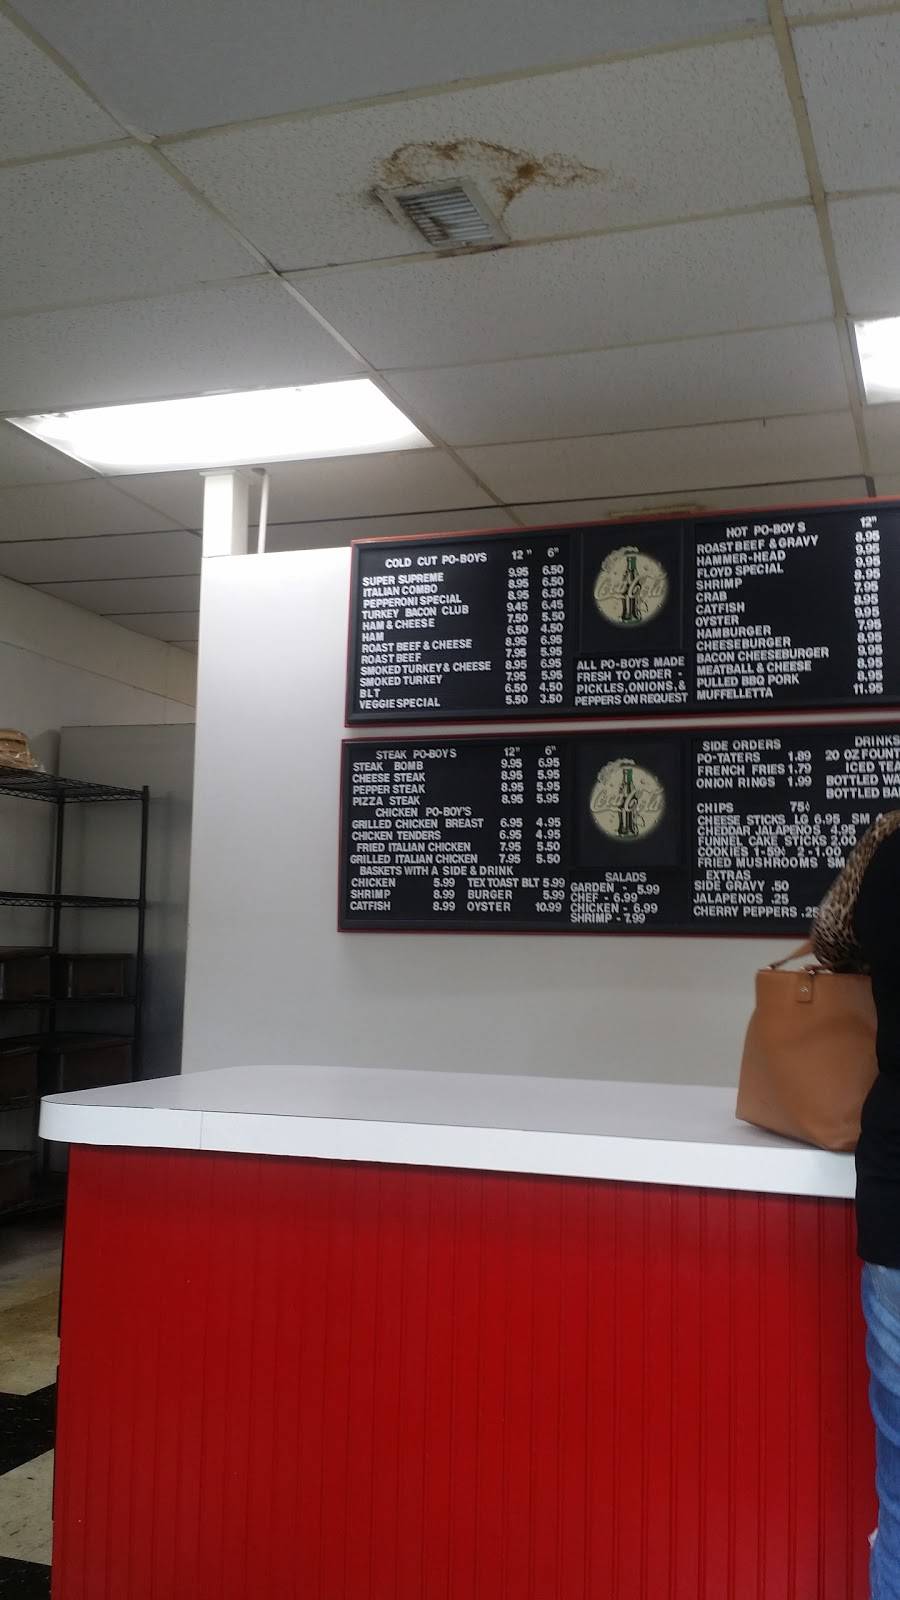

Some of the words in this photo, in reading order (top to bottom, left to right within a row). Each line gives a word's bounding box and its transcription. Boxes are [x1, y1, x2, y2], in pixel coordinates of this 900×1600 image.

[726, 526, 748, 538] HOT
[697, 542, 734, 554] ROAST
[735, 539, 765, 551] BEEF
[769, 538, 777, 549] &
[778, 535, 818, 548] GRAVY
[385, 558, 412, 568] COLD
[417, 556, 438, 566] CUT
[442, 553, 487, 564] PO-BOYS
[697, 550, 786, 566] HAMMER-HEAD
[697, 566, 732, 578] FLOYD
[735, 563, 784, 576] SPECIAL
[362, 576, 395, 586] SUPER
[398, 573, 444, 584] SUPREME
[696, 578, 742, 590] SHRIMP
[363, 586, 400, 597] ITALIAN
[401, 584, 438, 595] COMBO
[696, 591, 727, 602] CRAB
[363, 597, 418, 608] PEPPERONI
[419, 594, 462, 605] SPECIAL
[361, 609, 399, 619] TURKEY
[405, 607, 436, 617] BACON
[441, 605, 469, 615] CLUB
[696, 602, 745, 614] CATFISH
[362, 621, 384, 630] HAM
[386, 620, 393, 630] &
[395, 618, 435, 629] CHEESE
[696, 615, 739, 627] OYSTER
[362, 632, 384, 642] HAM
[697, 625, 771, 638] HAMBURGER
[362, 643, 394, 653] ROAST
[396, 641, 421, 651] BEEF
[423, 641, 430, 650] &
[432, 639, 472, 650] CHEESE
[696, 637, 791, 651] CHEESEBURGER
[361, 654, 395, 664] ROAST
[396, 653, 421, 663] BEEF
[697, 652, 734, 663] BACON
[738, 647, 829, 661] CHEESEBURGER
[360, 665, 401, 675] SMOKED
[402, 663, 441, 673] TURKEY
[441, 663, 450, 672] &
[453, 661, 491, 671] CHEESE
[577, 660, 597, 670] ALL
[601, 658, 649, 669] PO-BOYS
[654, 656, 684, 667] MADE
[697, 663, 754, 675] MEATBALL
[756, 662, 764, 673] &
[767, 660, 811, 672] CHEESE
[360, 676, 401, 687] SMOKED
[402, 675, 442, 685] TURKEY
[577, 671, 611, 682] FRESH
[616, 670, 631, 680] TO
[634, 669, 672, 680] ORDER
[697, 676, 738, 688] PULLED
[742, 675, 765, 686] BBQ
[768, 674, 799, 685] PORK
[360, 688, 380, 698] BLT
[575, 695, 621, 705] PEPPERS
[623, 694, 638, 704] ON
[640, 693, 688, 703] REQUEST
[697, 687, 773, 700] MUFFELLETTA
[359, 699, 395, 709] VEGGIE
[396, 698, 440, 708] SPECIAL
[702, 741, 728, 751] SIDE
[733, 739, 781, 750] ORDERS
[376, 750, 407, 760] STEAK
[697, 752, 760, 763] PO-TATERS
[788, 751, 811, 761] 1.89
[353, 762, 383, 771] STEAK
[394, 761, 423, 770] BOMB
[698, 765, 745, 776] FRENCH
[752, 764, 785, 775] FRIES
[788, 763, 812, 774] 1.79
[846, 761, 875, 773] ICED
[352, 773, 390, 783] CHEESE
[393, 773, 425, 782] STEAK
[696, 778, 733, 788] ONION
[738, 777, 775, 788] RINGS
[788, 776, 812, 787] 1.99
[353, 785, 390, 794] PEPPER
[392, 784, 425, 794] STEAK
[353, 796, 383, 806] PIZZA
[389, 796, 420, 805] STEAK
[375, 808, 418, 817] CHICKEN
[697, 802, 733, 813] CHIPS
[352, 820, 392, 829] GRILLED
[395, 819, 438, 828] CHICKEN
[445, 818, 484, 828] BREAST
[697, 815, 740, 826] CHEESE
[747, 814, 787, 825] STICKS
[352, 831, 393, 840] CHICKEN
[397, 831, 441, 840] TENDERS
[697, 825, 750, 836] CHEDDAR
[755, 824, 821, 836] JALAPENOS
[357, 843, 385, 852] FRIED
[388, 842, 425, 852] ITALIAN
[428, 842, 471, 852] CHICKEN
[698, 836, 743, 847] FUNNEL
[748, 835, 778, 847] CAKE
[784, 835, 827, 846] STICKS
[698, 846, 748, 857] COOKIES
[350, 855, 391, 864] GRILLED
[395, 854, 433, 864] ITALIAN
[435, 854, 478, 864] CHICKEN
[698, 857, 732, 868] FRIED
[736, 857, 818, 868] MUSHROOMS
[360, 866, 402, 875] BASKETS
[404, 866, 429, 875] WITH
[431, 866, 439, 875] A
[443, 866, 467, 875] SIDE
[470, 866, 477, 875] &
[479, 866, 513, 875] DRINK
[706, 870, 751, 881] EXTRAS
[351, 878, 395, 887] CHICKEN
[433, 878, 455, 887] 5.99
[467, 878, 486, 887] TEX
[487, 878, 519, 887] TOAST
[522, 878, 540, 888] BLT
[543, 878, 565, 888] 5.99
[605, 872, 647, 882] SALADS
[570, 882, 614, 892] GARDEN
[637, 884, 660, 895] 5.99
[694, 880, 721, 891] SIDE
[726, 880, 765, 891] GRAVY
[350, 889, 391, 899] SHRIMP
[433, 889, 455, 899] 8.99
[468, 890, 512, 899] BURGER
[543, 890, 565, 900] 5.99
[570, 892, 598, 902] CHEF
[613, 892, 638, 903] 6.99
[693, 893, 763, 904] JALAPENOS
[350, 901, 390, 910] CATFISH
[433, 901, 455, 911] 8.99
[467, 901, 510, 911] OYSTER
[535, 902, 562, 912] 10.99
[570, 903, 619, 913] CHICKEN
[633, 903, 658, 914] 6.99
[693, 906, 738, 916] CHERRY
[743, 906, 797, 917] PEPPERS
[571, 912, 612, 923] SHRIMP
[623, 913, 645, 924] 7.99
